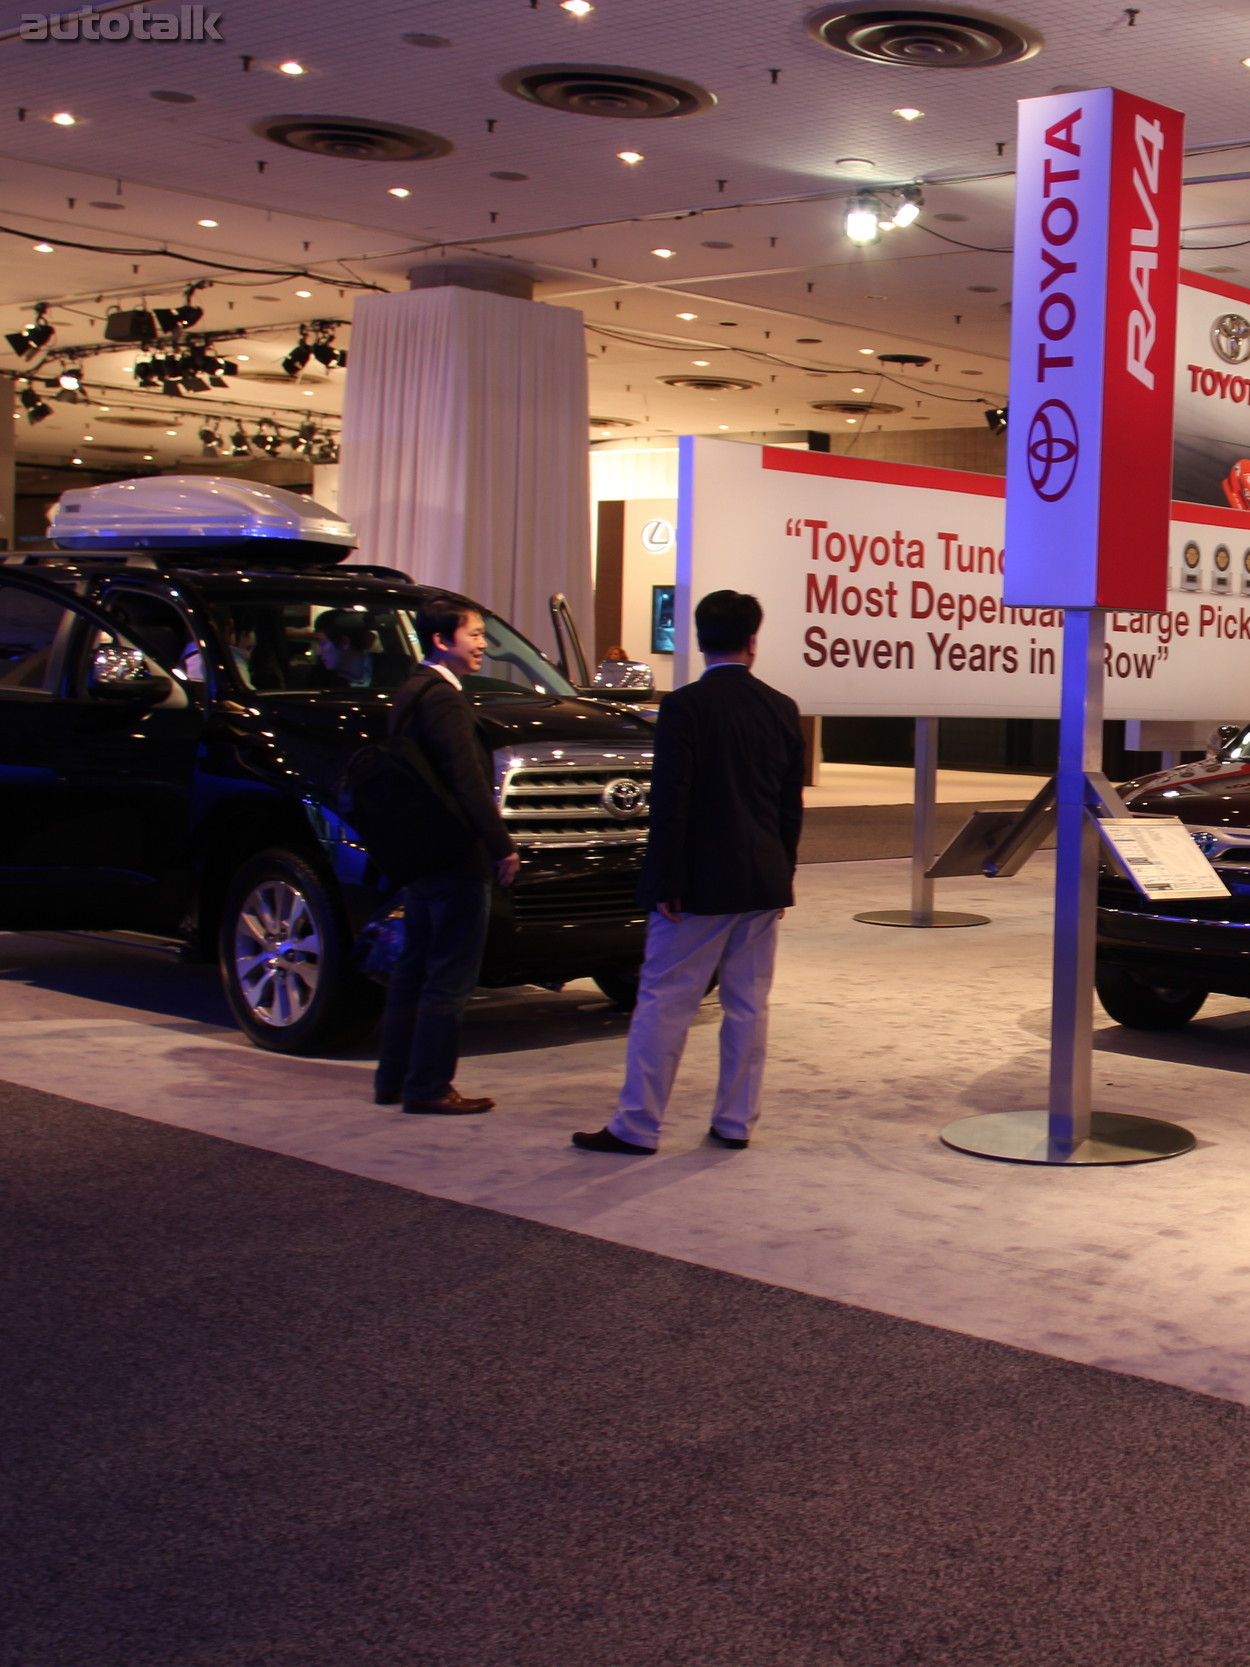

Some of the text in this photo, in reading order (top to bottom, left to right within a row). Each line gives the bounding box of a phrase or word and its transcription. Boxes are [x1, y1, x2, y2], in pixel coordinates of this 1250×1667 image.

[1037, 107, 1083, 383] TOYOTA
[1126, 113, 1164, 391] RAV4
[785, 517, 925, 573] “Toyota
[805, 572, 898, 618] Most
[803, 625, 914, 669] Seven
[926, 632, 1019, 675] Years
[1029, 637, 1056, 675] in
